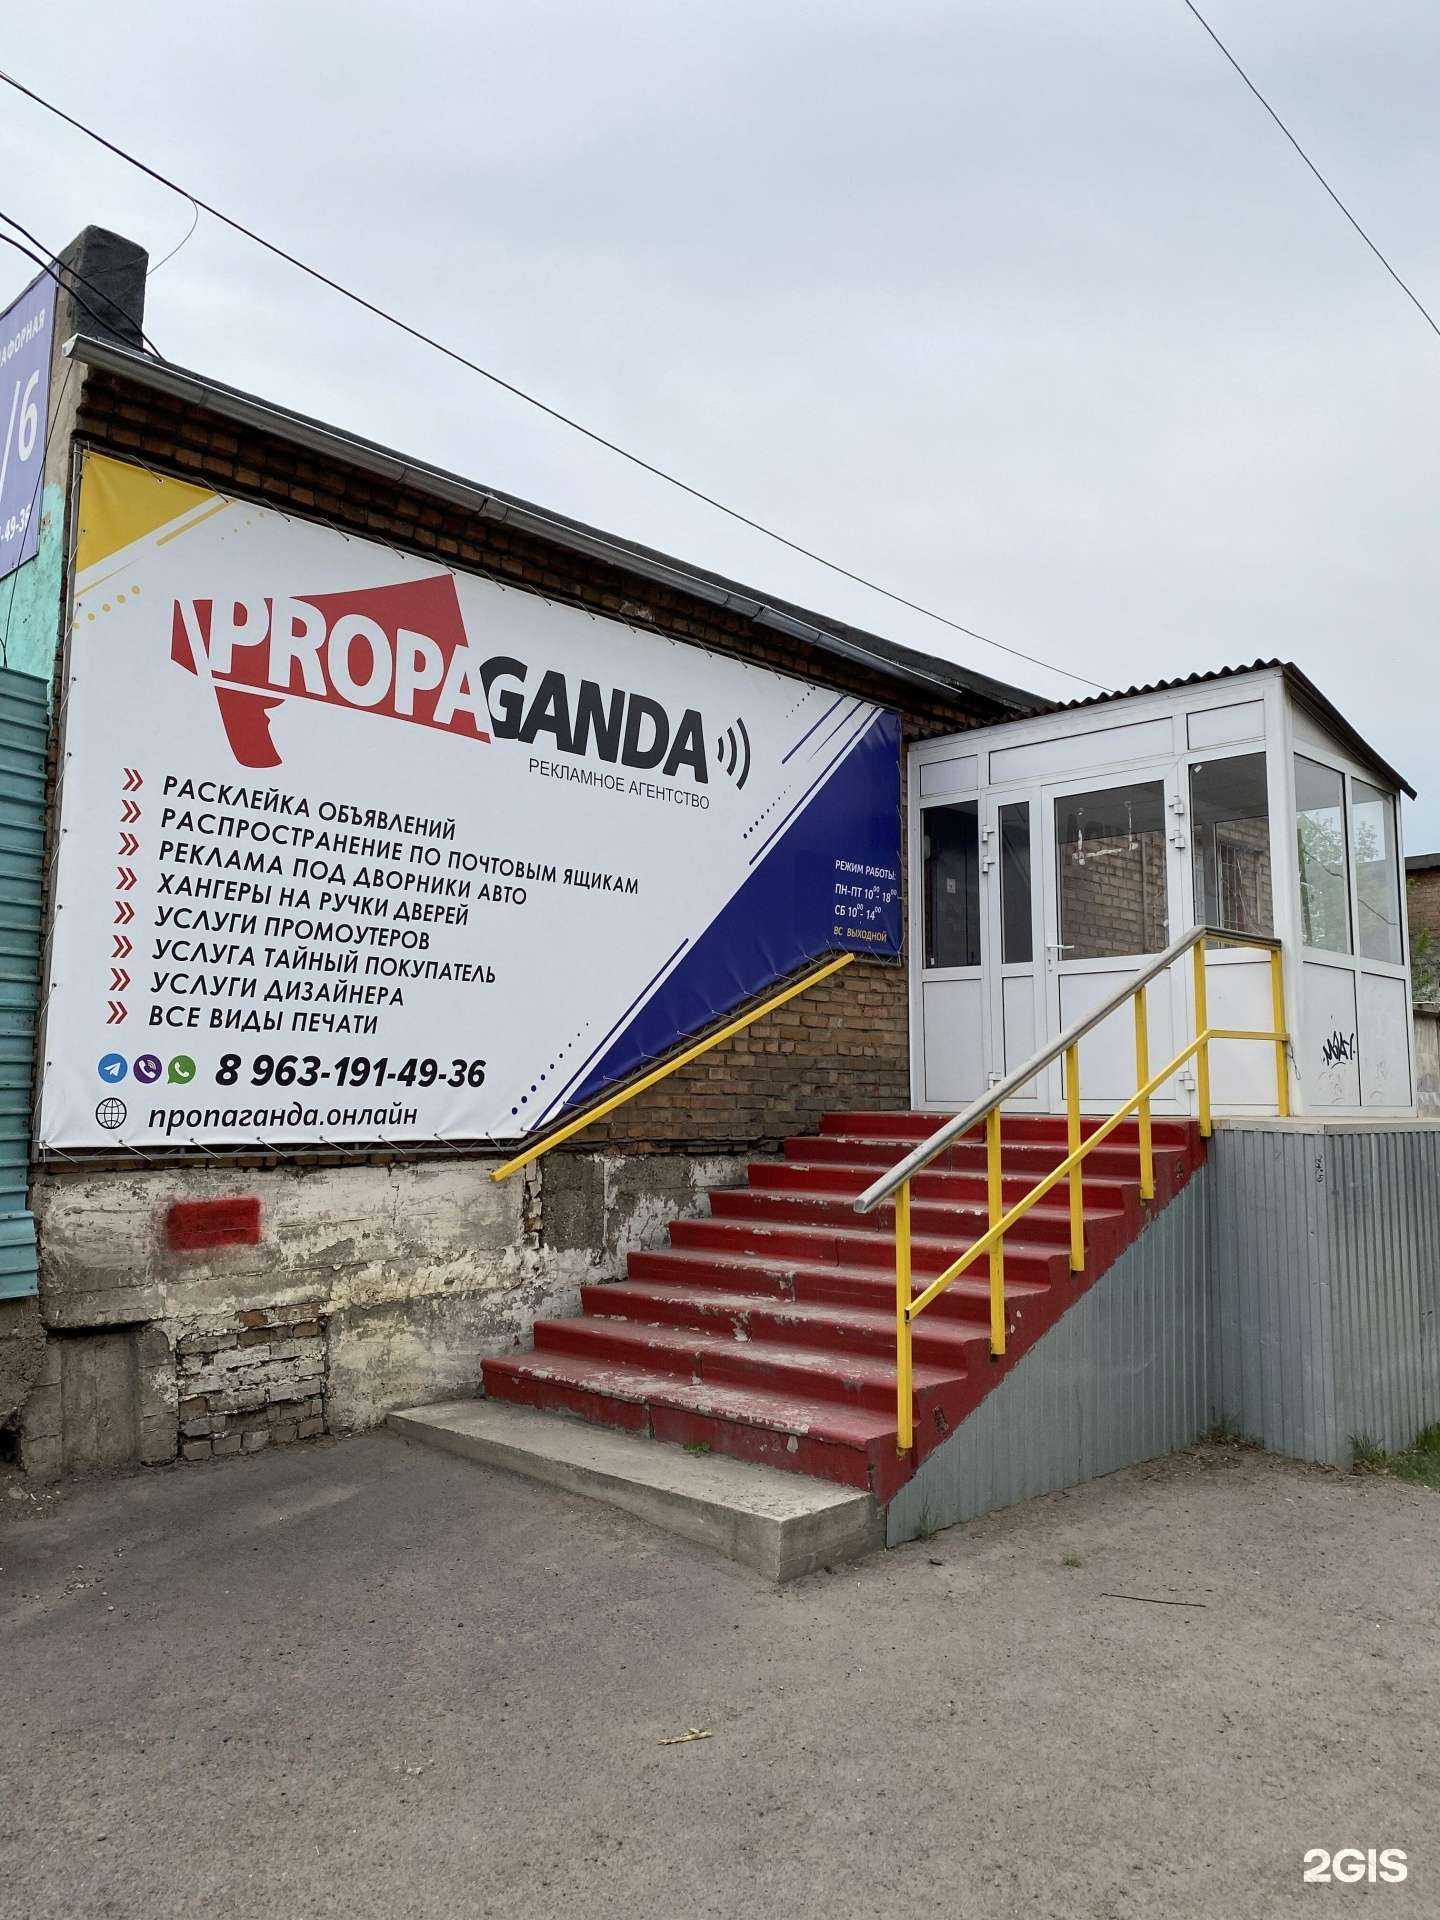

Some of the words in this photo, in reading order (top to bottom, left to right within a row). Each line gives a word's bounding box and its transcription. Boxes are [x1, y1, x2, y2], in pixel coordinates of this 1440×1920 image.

[208, 597, 709, 784] PROPAGANDA
[529, 757, 625, 792] РЕКЛАМНОЕ
[629, 780, 710, 810] АГЕНТСТВО
[162, 775, 310, 817] РАСКЛЕЙКА
[318, 801, 456, 840] ОБЪЯВЛЕНИЙ
[161, 807, 403, 861] РАСПРОСТРАНЕНИЕ
[409, 845, 441, 866] ПО
[447, 851, 556, 883] ПОЧТОВЫМ
[562, 868, 639, 895] ЯЩИКАМ
[835, 859, 864, 875] РЕЖИМ
[865, 865, 897, 881] РАБОТЫ:
[158, 840, 283, 875] РЕКЛАМА
[292, 857, 346, 886] ПОД
[352, 866, 471, 899] ДВОРНИКИ
[477, 883, 527, 905] АВТО
[834, 883, 863, 898] ПН-ПТ
[157, 873, 272, 905] ХАНГЕРЫ
[278, 887, 311, 909] НА
[318, 891, 389, 918] РУЧКИ
[392, 901, 470, 926] ДВЕРЕЙ
[834, 904, 846, 916] СБ
[154, 905, 258, 935] УСЛУГИ
[264, 916, 430, 950] ПРОМОУТЕРОВ
[833, 926, 844, 936] ВС
[846, 927, 887, 942] ВЫХОДНОЙ
[151, 938, 256, 966] УСЛУГА
[264, 945, 359, 974] ТАЙНЫЙ
[364, 956, 496, 984] ПОКУПАТЕЛЬ
[150, 971, 258, 998] УСЛУГИ
[263, 979, 404, 1006] ДИЗАЙНЕРА
[149, 1004, 201, 1028] ВСЕ
[209, 1008, 284, 1033] ВИДЫ
[291, 1012, 379, 1034] ПЕЧАТИ
[214, 1053, 243, 1086] 8
[250, 1054, 487, 1088] 963-191-49-36
[148, 1101, 418, 1136] пропаганда.онлайн
